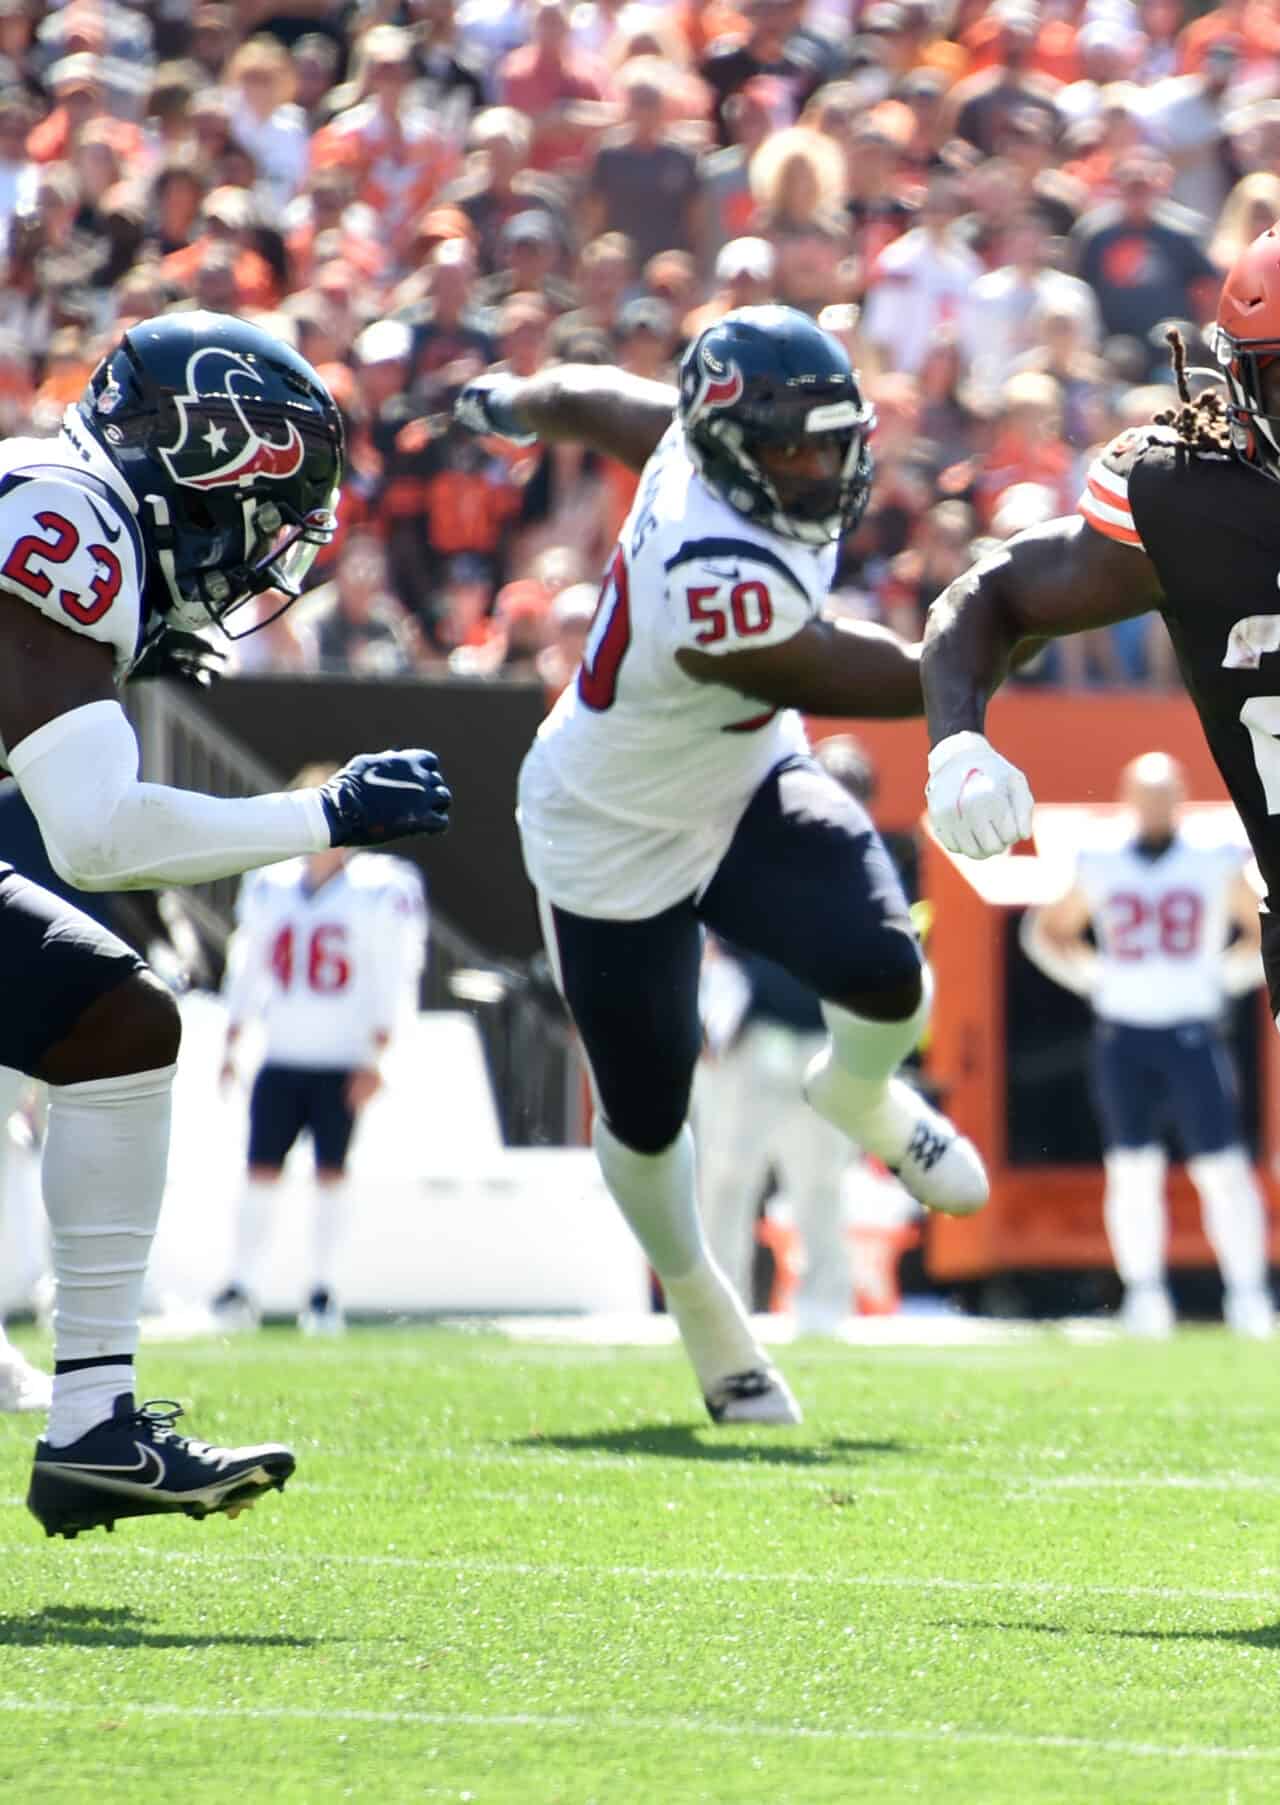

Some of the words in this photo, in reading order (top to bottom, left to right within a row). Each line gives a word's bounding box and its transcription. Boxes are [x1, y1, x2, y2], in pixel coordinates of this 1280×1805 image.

[2, 511, 122, 626] 23
[686, 581, 773, 644] 50
[266, 920, 352, 995] 46
[1105, 888, 1206, 962] 28
